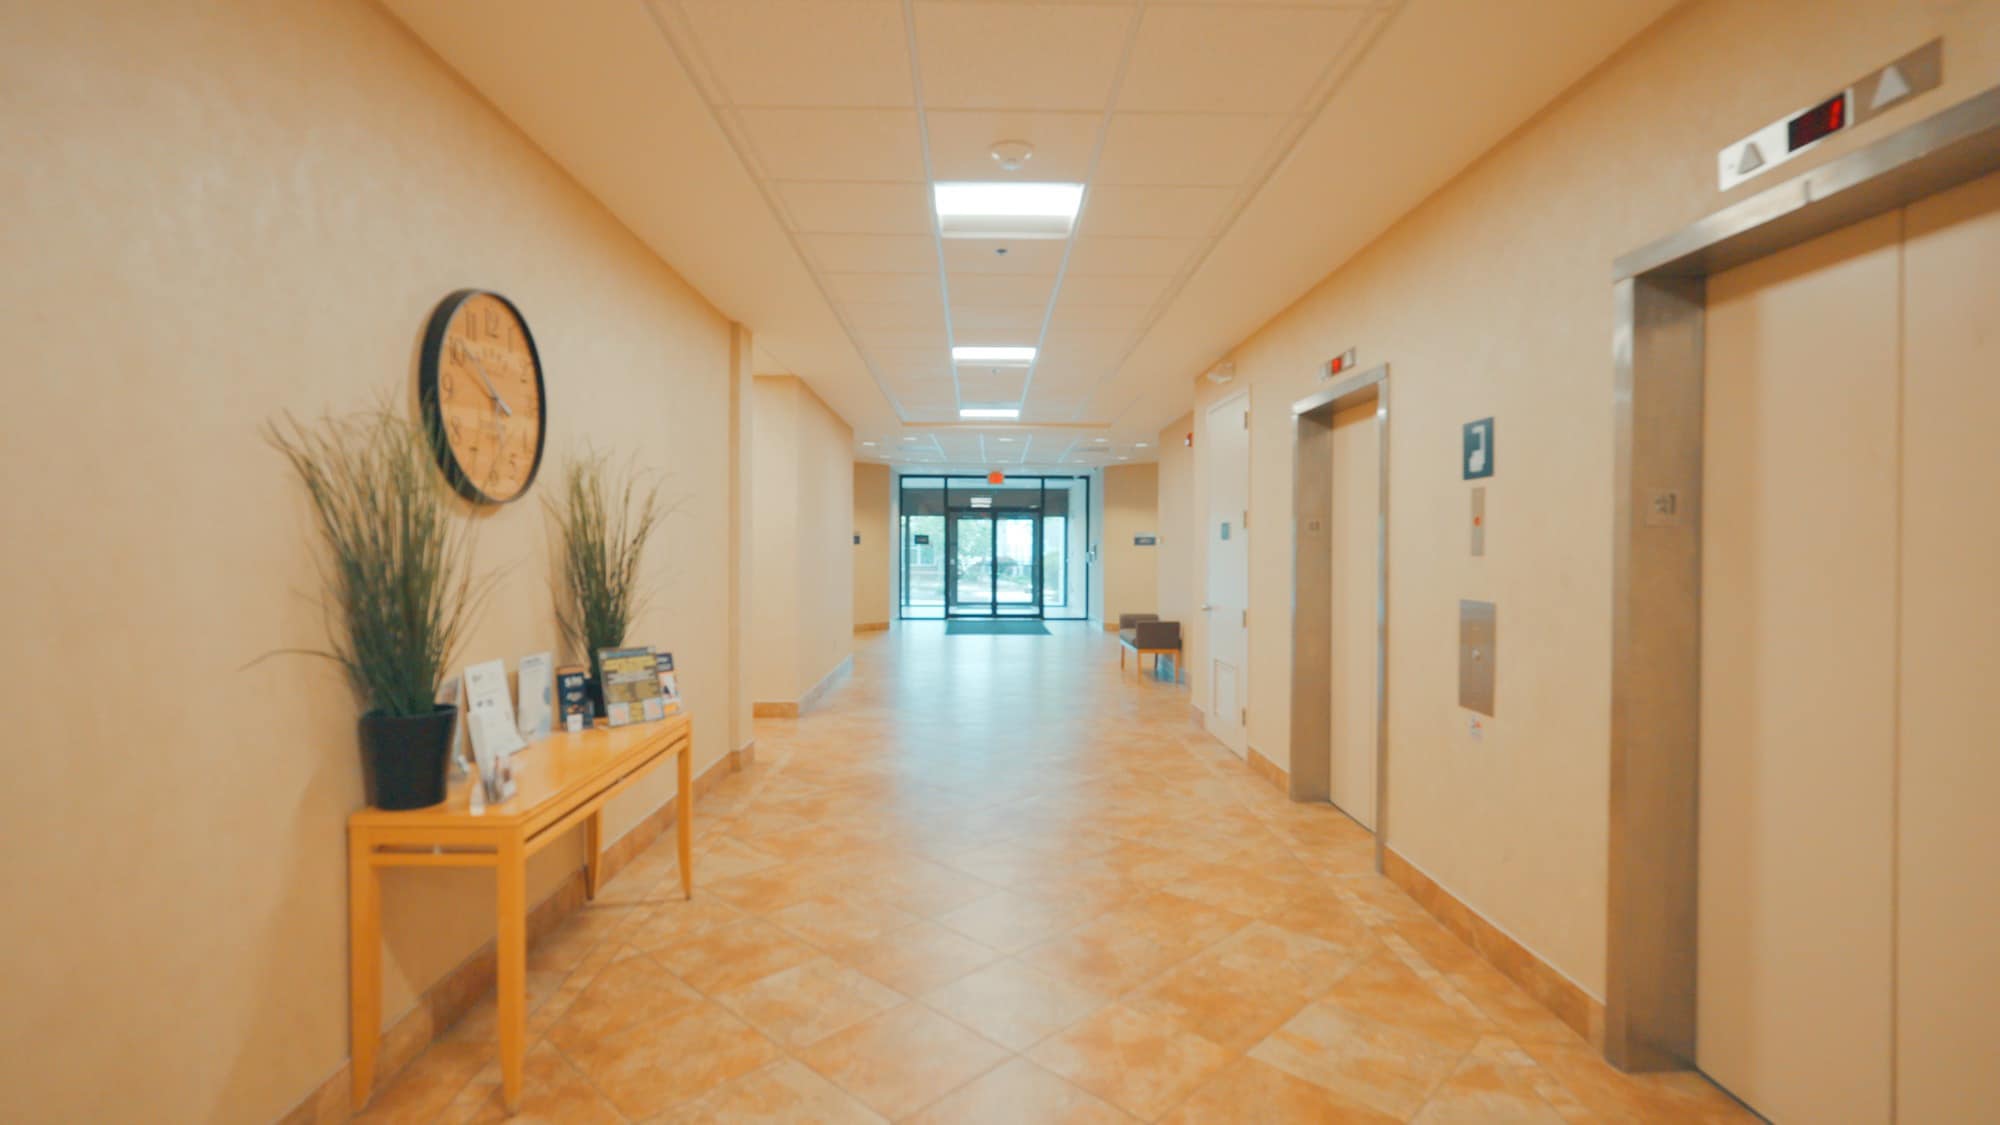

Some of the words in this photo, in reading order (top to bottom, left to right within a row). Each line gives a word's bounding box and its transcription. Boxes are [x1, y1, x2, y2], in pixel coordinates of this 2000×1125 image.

[465, 310, 478, 342] 11
[484, 307, 500, 339] 12
[441, 372, 453, 400] 9
